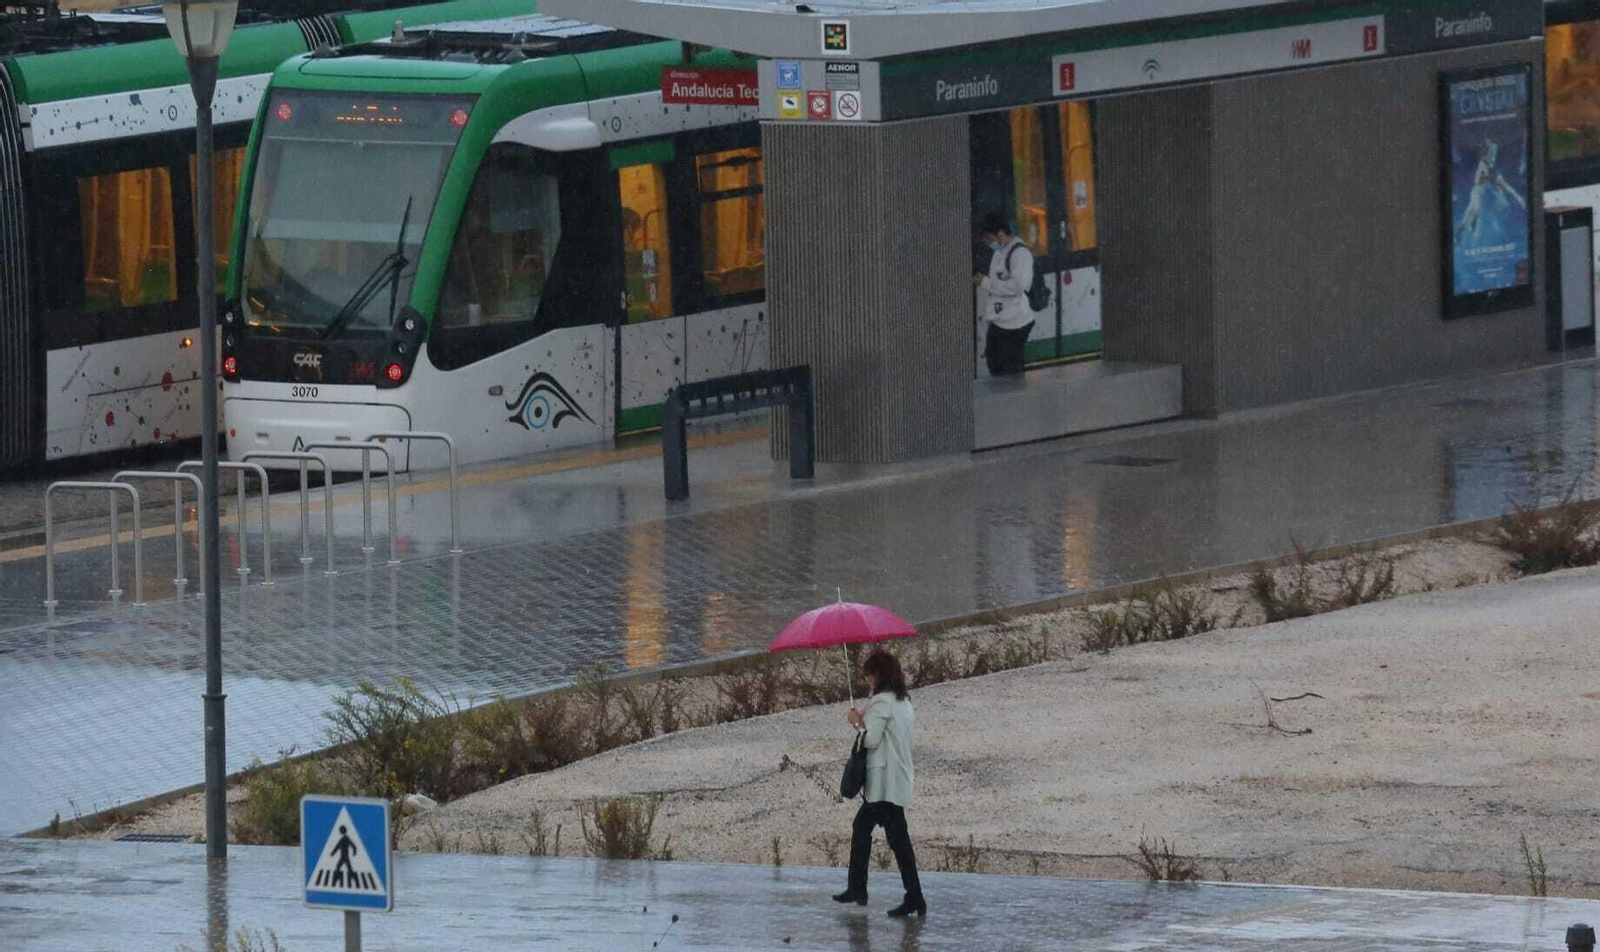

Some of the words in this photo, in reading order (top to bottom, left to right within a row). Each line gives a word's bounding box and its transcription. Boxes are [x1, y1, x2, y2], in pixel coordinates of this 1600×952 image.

[1434, 11, 1493, 38] Paraninfo
[827, 64, 857, 73] AENOR
[672, 82, 735, 98] Andalucía
[936, 74, 998, 101] Paraninfo
[293, 353, 322, 368] CAF
[292, 386, 319, 398] 3070
